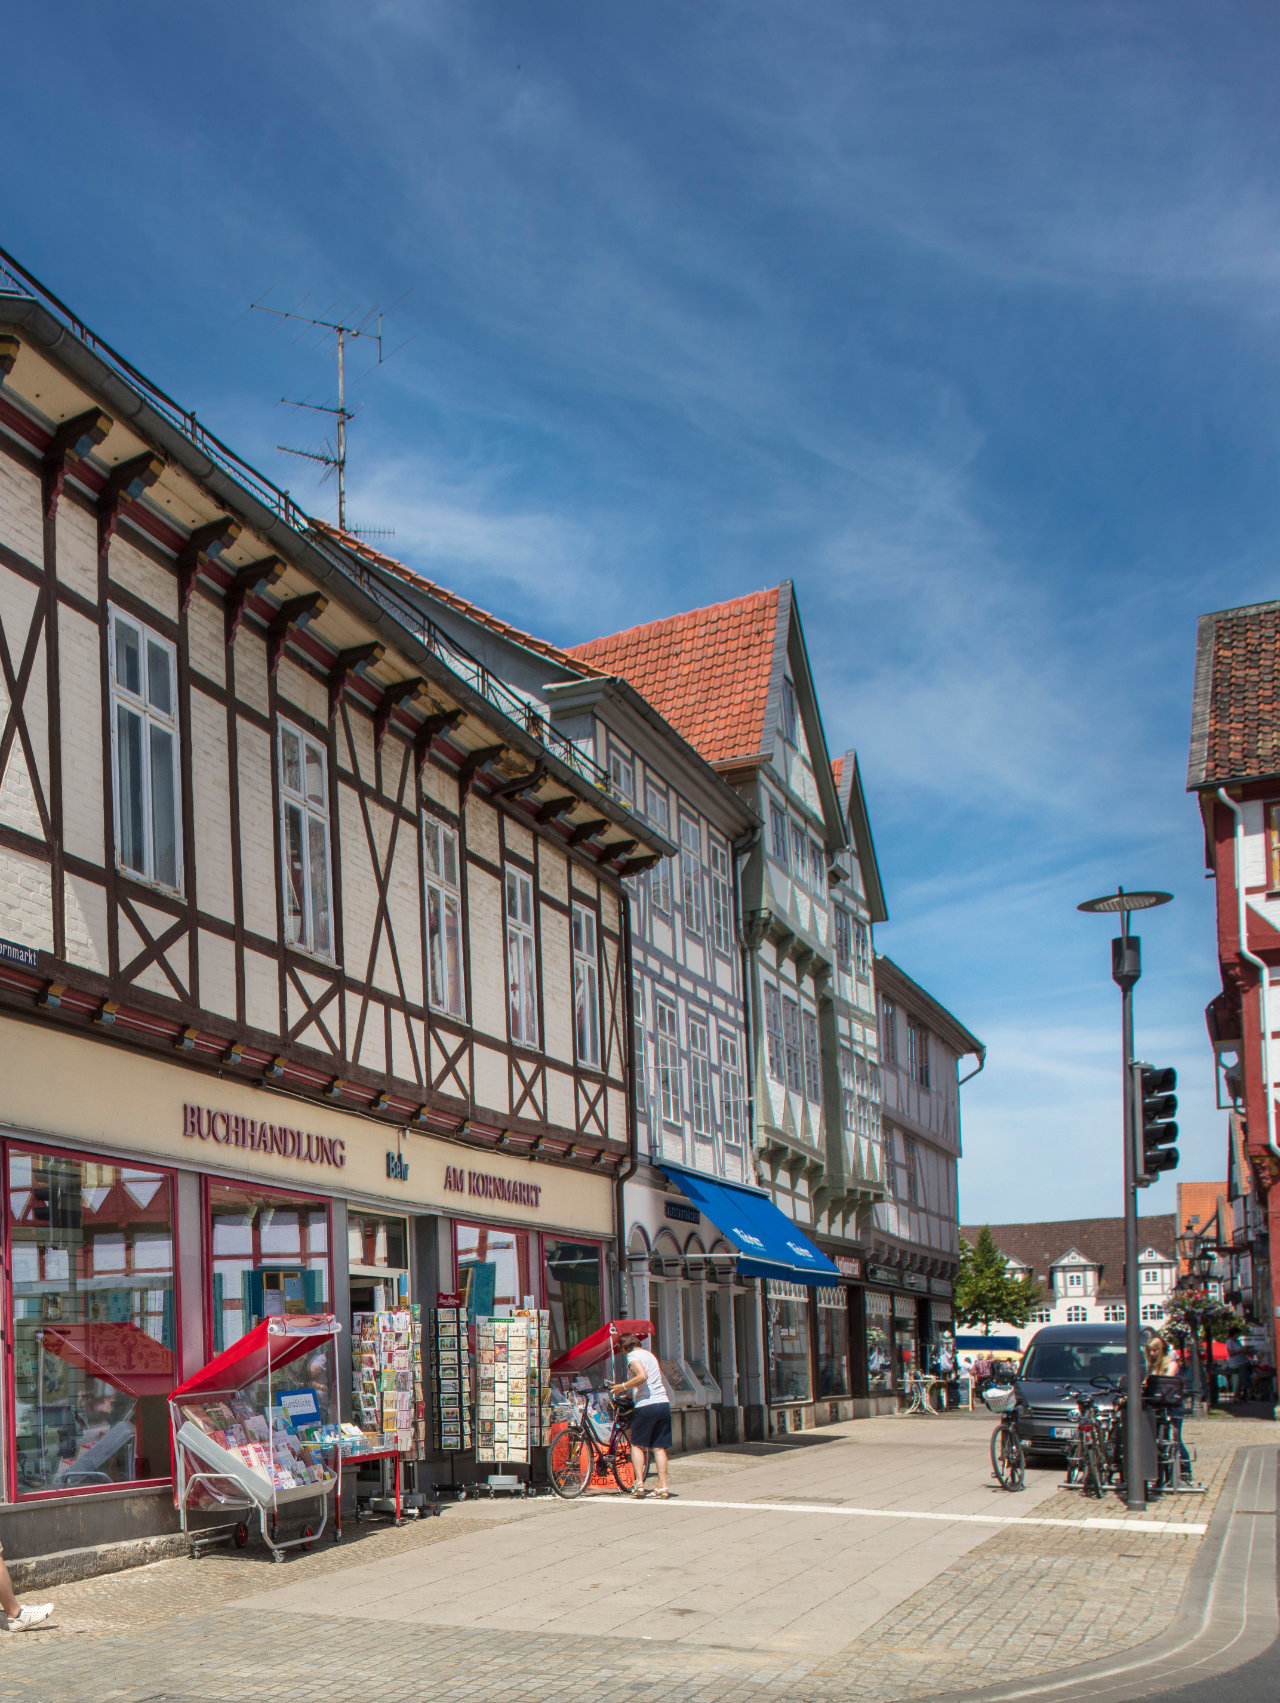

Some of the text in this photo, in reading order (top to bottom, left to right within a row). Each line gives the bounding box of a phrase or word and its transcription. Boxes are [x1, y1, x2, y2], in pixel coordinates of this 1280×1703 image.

[183, 1103, 542, 1207] BUCHHANDLUNG Behr AM KORNMARKT
